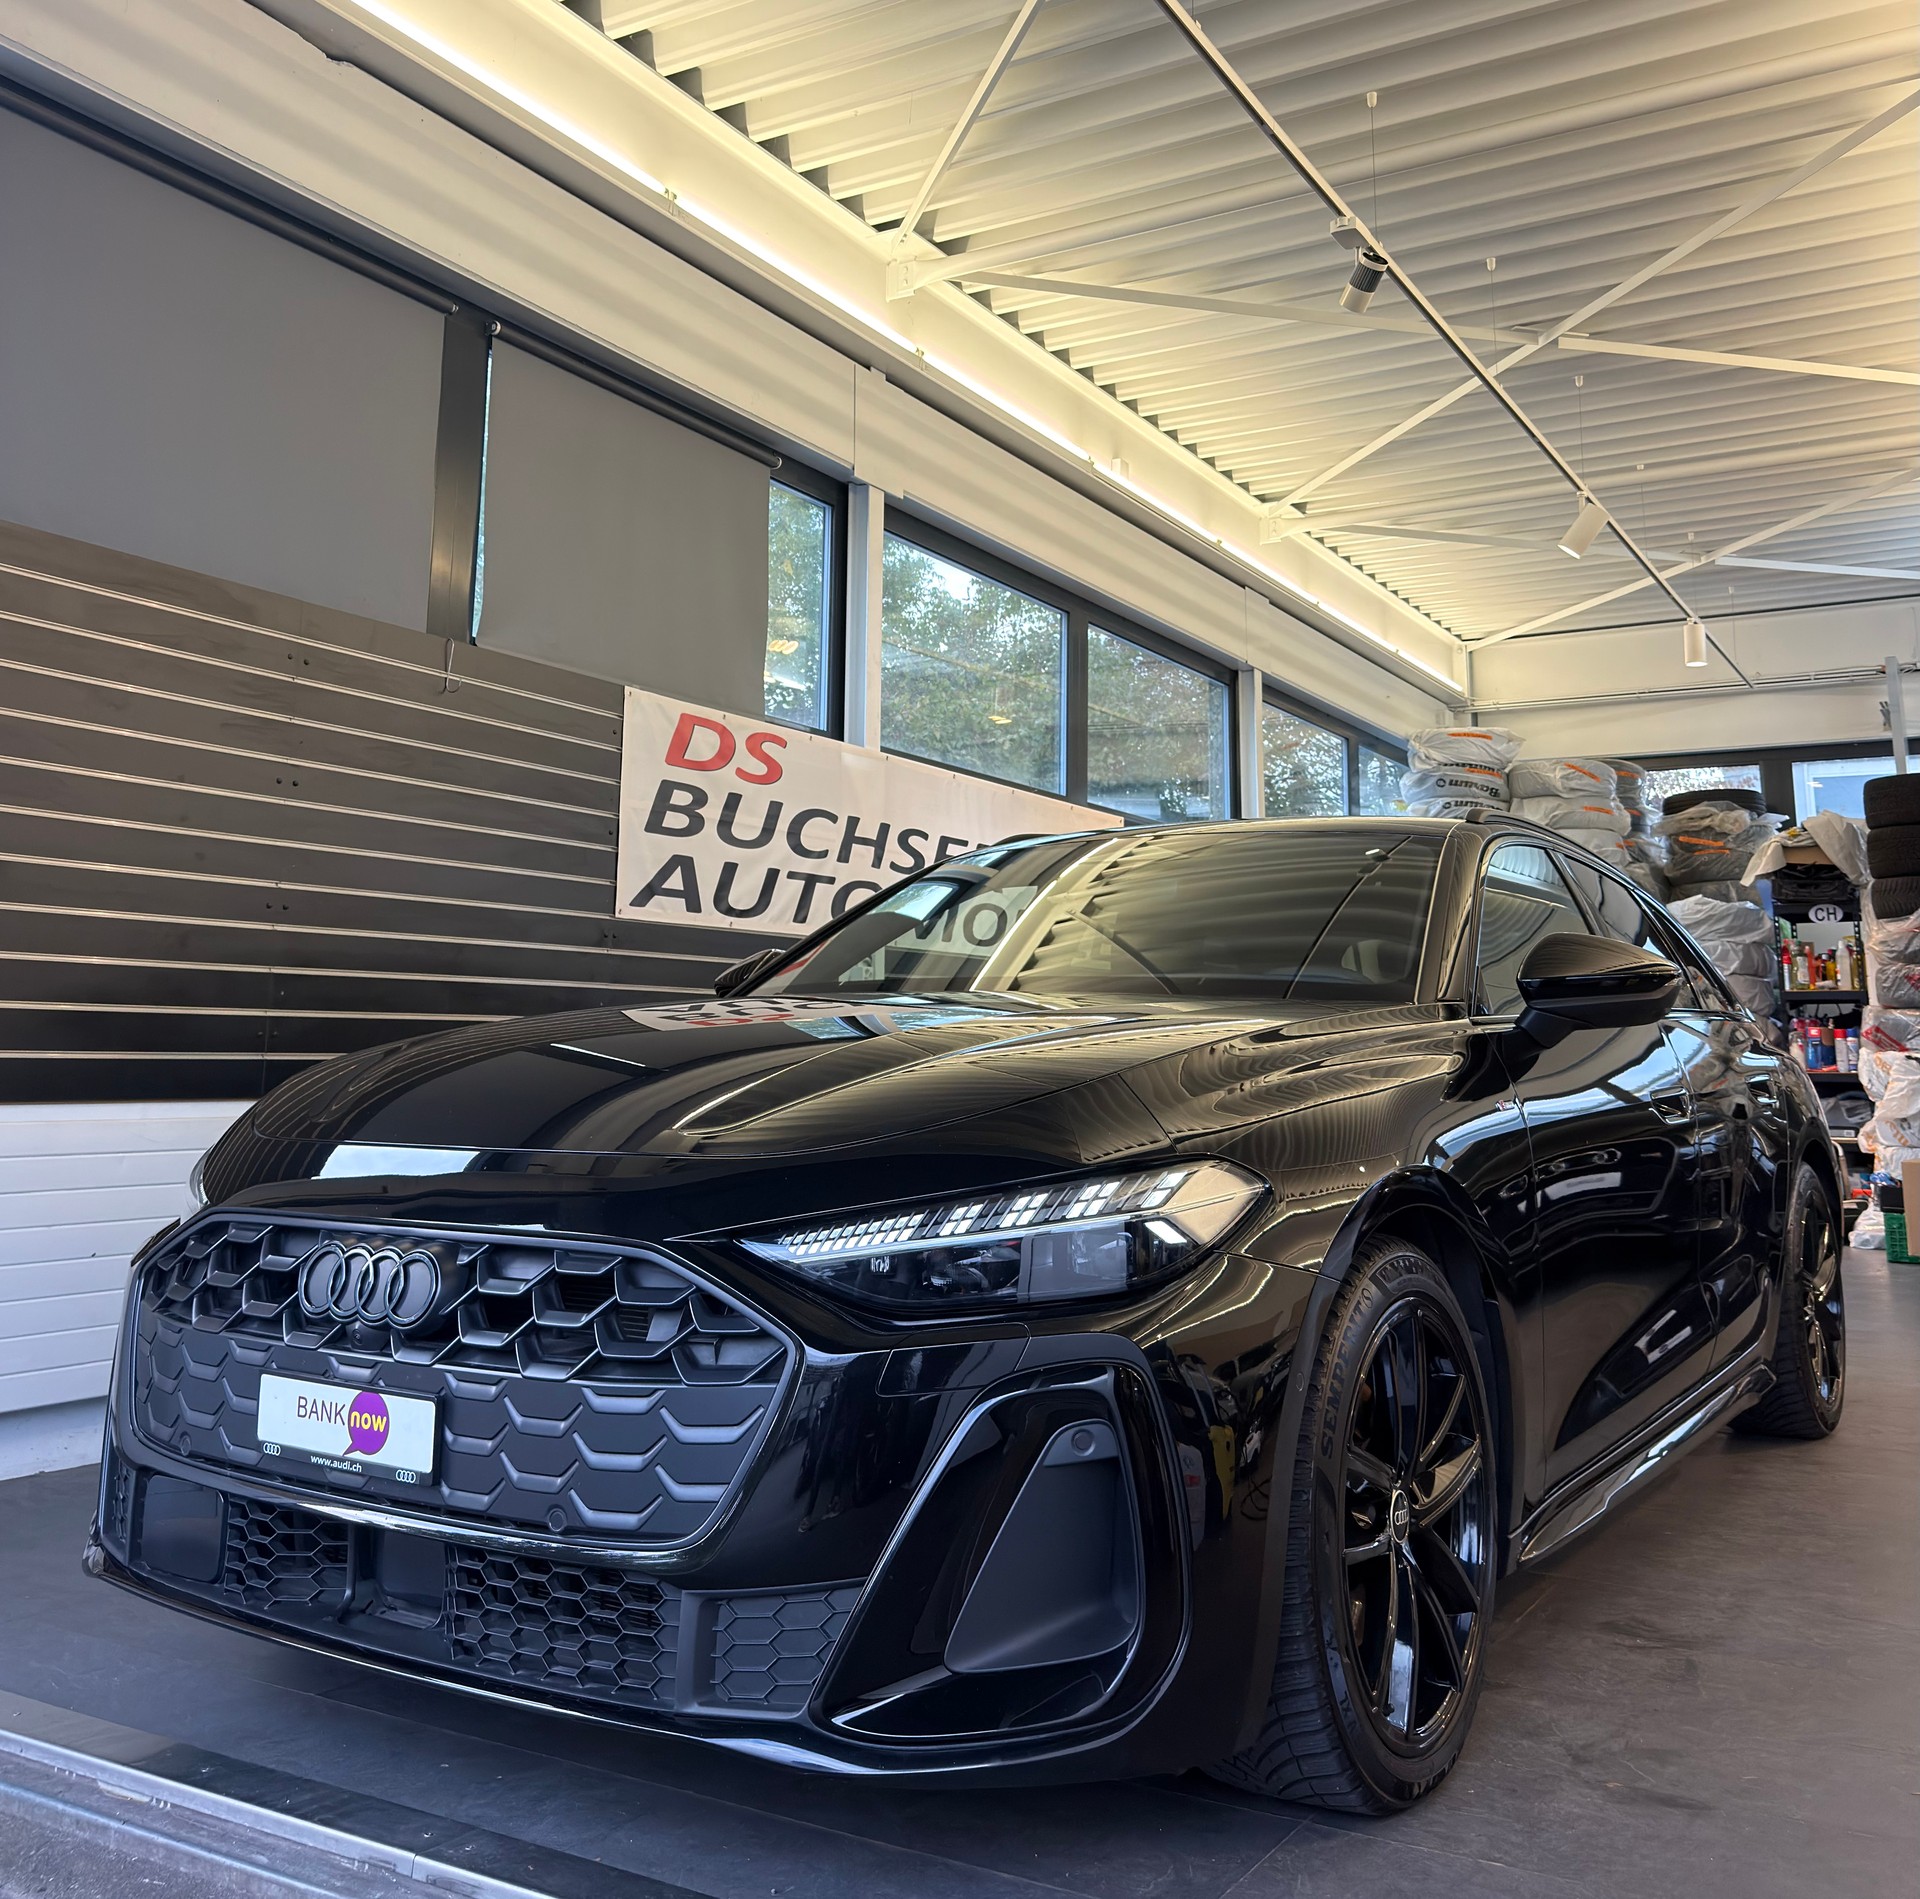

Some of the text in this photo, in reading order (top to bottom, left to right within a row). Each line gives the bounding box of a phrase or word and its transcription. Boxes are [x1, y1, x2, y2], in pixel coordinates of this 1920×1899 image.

[664, 712, 787, 785] DS
[643, 779, 990, 875] BUCHSE
[1814, 907, 1838, 922] CH
[1322, 1303, 1364, 1458] SEMPERIT
[297, 1395, 387, 1433] BANK now
[310, 1455, 362, 1473] www.audi.ch
